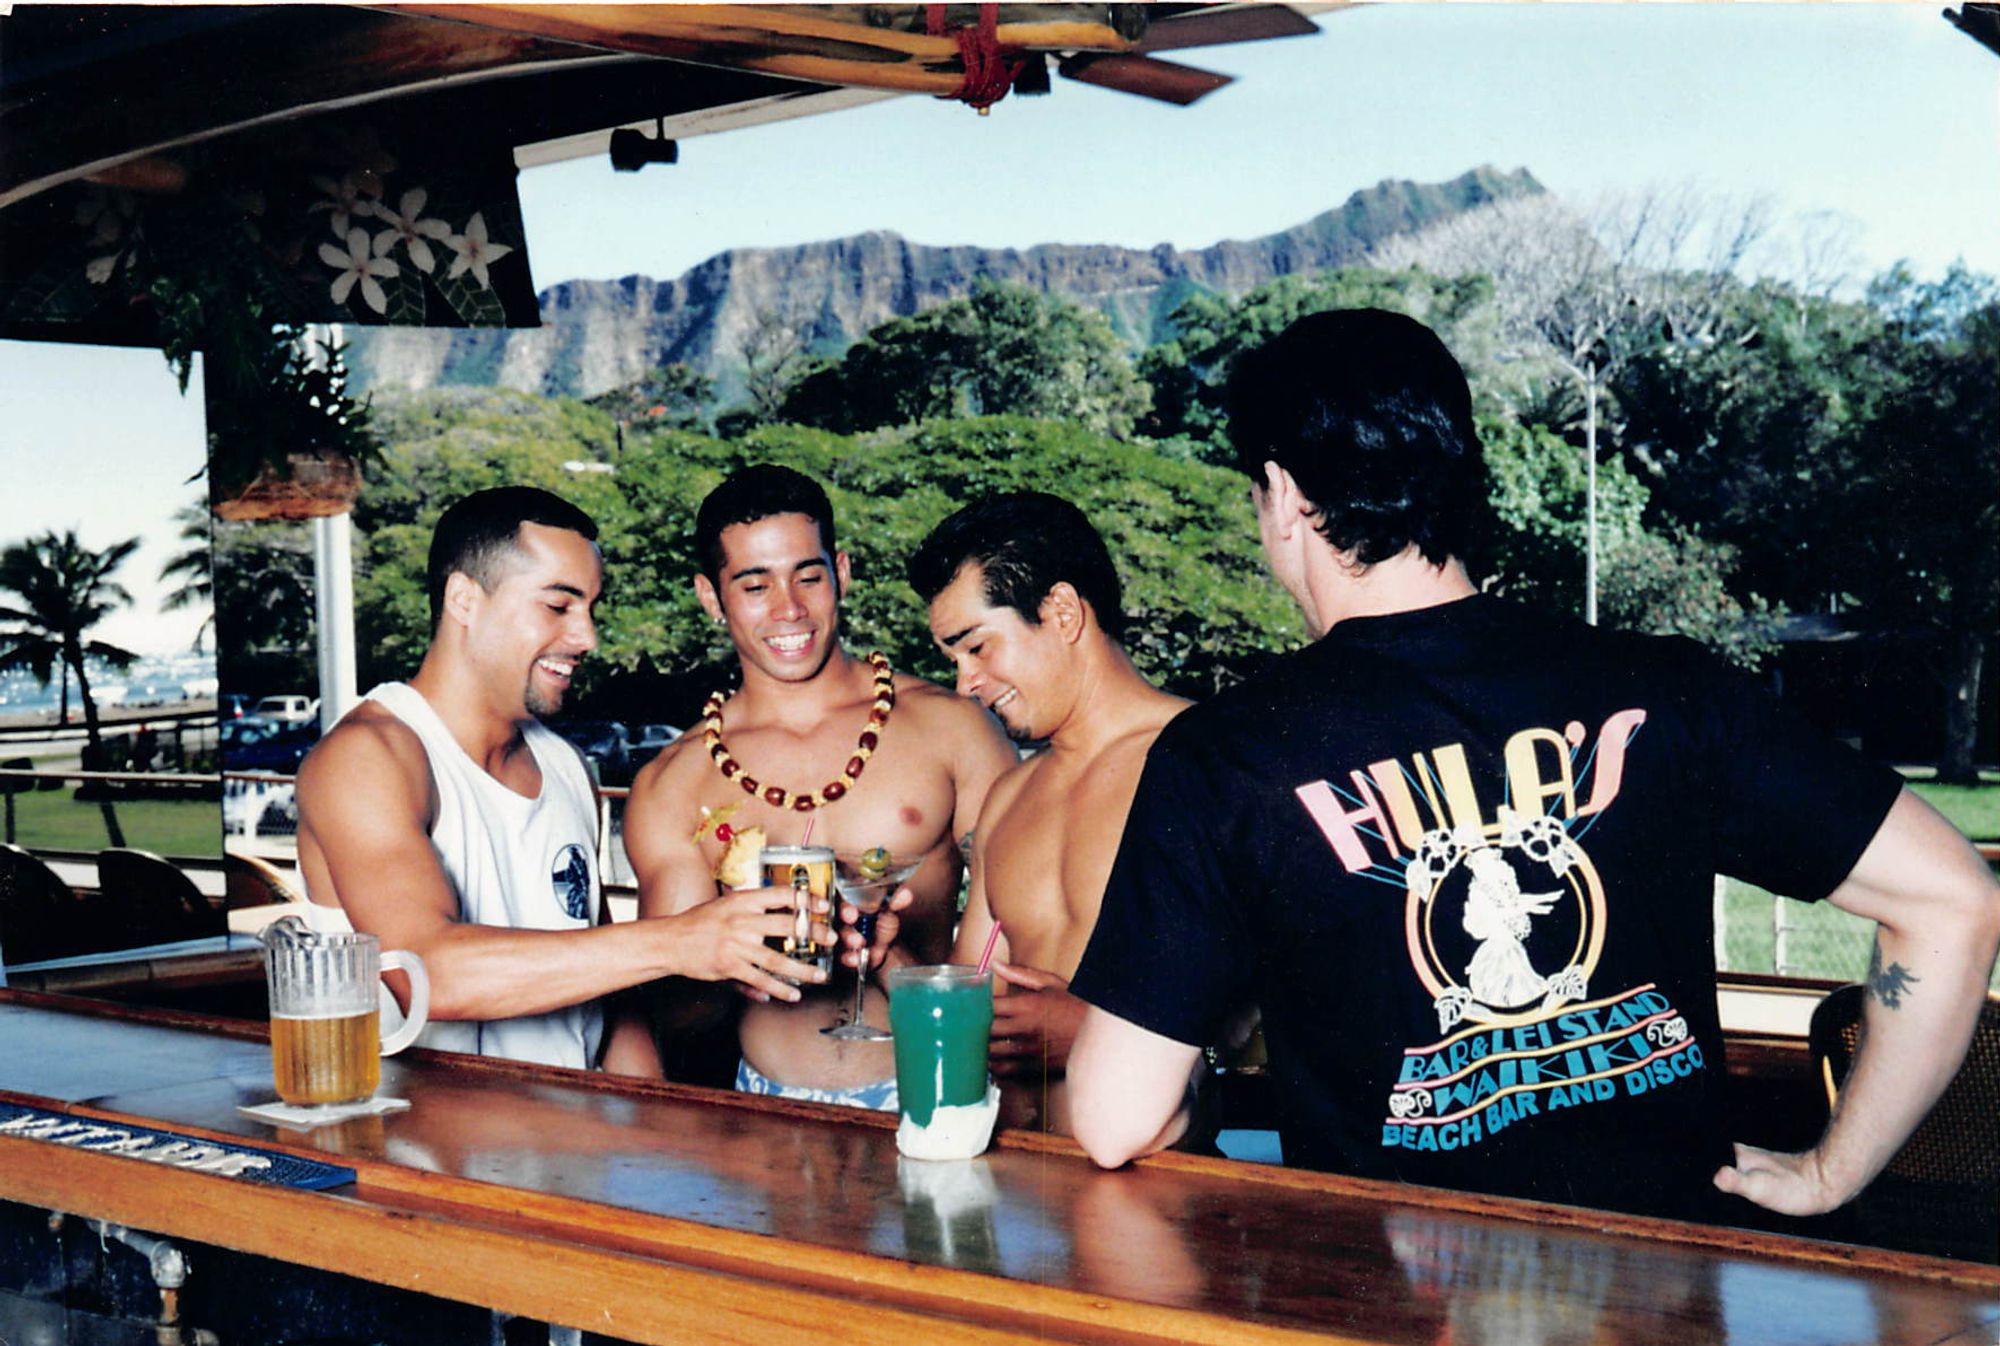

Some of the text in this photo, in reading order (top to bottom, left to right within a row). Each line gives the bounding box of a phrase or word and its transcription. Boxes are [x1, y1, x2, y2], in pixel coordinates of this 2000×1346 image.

[1296, 708, 1647, 873] HULA'S
[1557, 991, 1670, 1040] STAND
[1381, 1044, 1704, 1152] BEACH BAR AND DISCO
[1433, 1033, 1651, 1116] WAIKIKI
